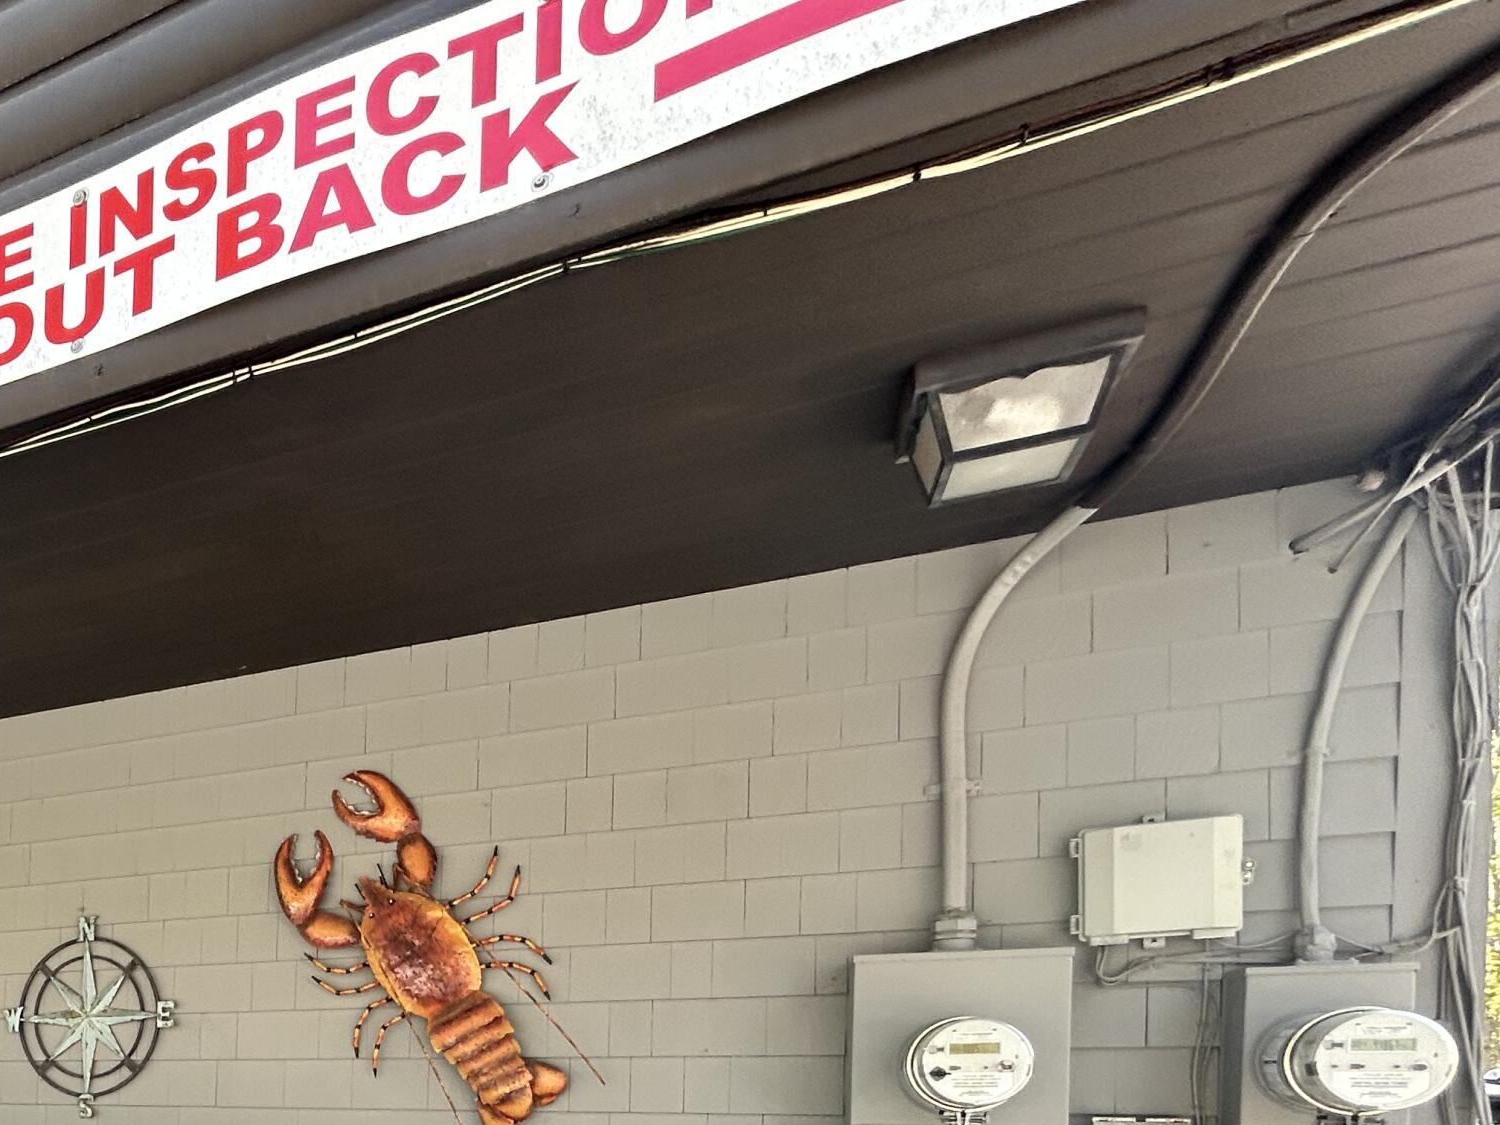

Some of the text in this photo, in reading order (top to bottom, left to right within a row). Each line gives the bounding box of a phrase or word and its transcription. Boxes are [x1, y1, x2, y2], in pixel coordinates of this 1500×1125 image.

[68, 0, 713, 269] INSPECTIO
[215, 79, 581, 282] BACK
[77, 915, 98, 942] N
[3, 1006, 24, 1032] W
[156, 1000, 177, 1029] E
[77, 1094, 95, 1119] S
